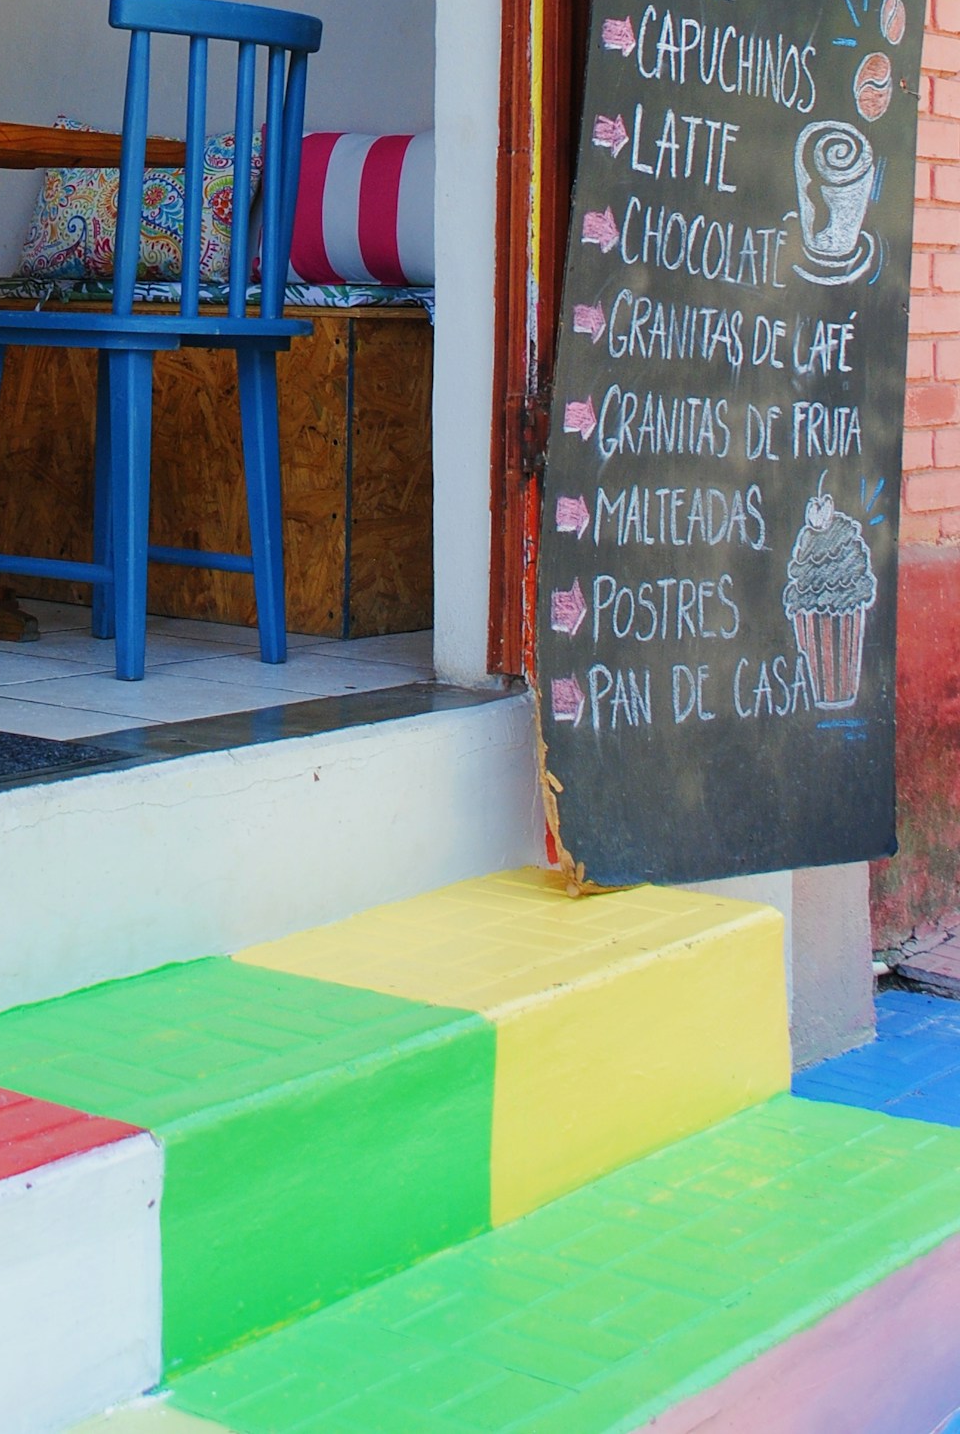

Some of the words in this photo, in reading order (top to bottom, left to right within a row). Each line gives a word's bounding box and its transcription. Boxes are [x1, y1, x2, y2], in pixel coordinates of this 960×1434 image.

[637, 4, 817, 114] CAPUCHINOS
[631, 102, 740, 193] LATTE
[608, 288, 743, 366] GRANITAS
[751, 314, 787, 368] DE
[793, 311, 858, 373] CAFÉ
[598, 383, 730, 461] GRANITAS
[745, 403, 780, 462] DE
[792, 400, 863, 460] FRUTA
[594, 483, 768, 551] MALTEADAS
[593, 573, 740, 643] POSTRES
[588, 663, 652, 731] PAN
[672, 664, 717, 725] DE
[733, 652, 811, 717] CASA
